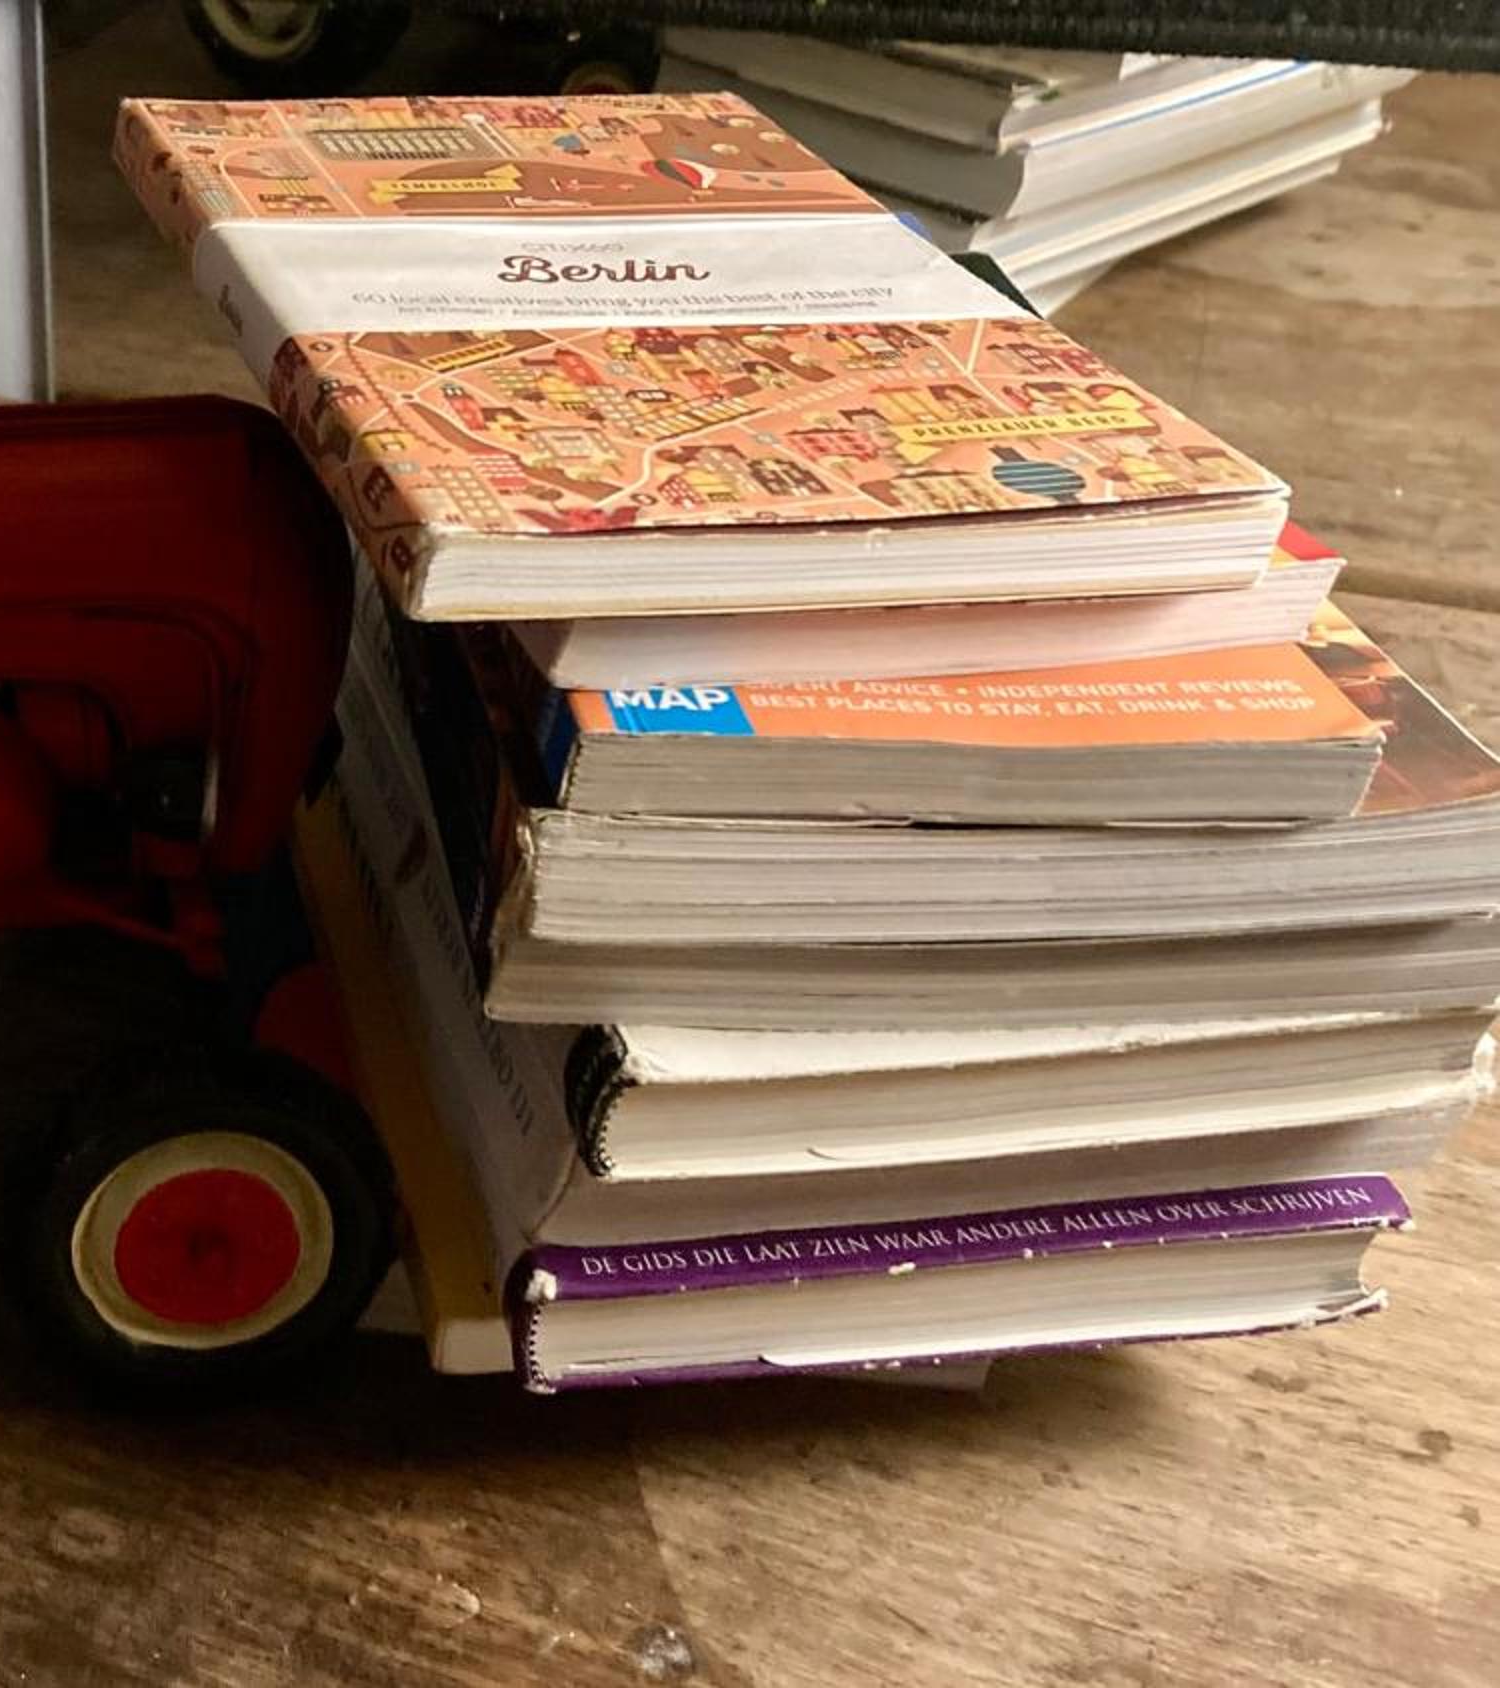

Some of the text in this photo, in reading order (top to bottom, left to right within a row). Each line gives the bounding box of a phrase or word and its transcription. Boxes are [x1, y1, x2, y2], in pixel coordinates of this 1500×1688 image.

[498, 255, 711, 283] Berlin
[390, 289, 450, 304] local
[453, 293, 561, 305] creatives
[563, 297, 631, 308] bring
[633, 298, 679, 308] you
[681, 295, 721, 305] the
[723, 292, 777, 303] best
[780, 290, 803, 300] of
[806, 290, 847, 300] the
[851, 286, 893, 298] city
[912, 415, 1128, 438] PRENZLAUER BERG
[610, 686, 731, 712] MAP
[854, 682, 949, 697] ADVICE
[978, 681, 1170, 699] INDEPENDENT
[1179, 679, 1306, 695] REVIEWS
[749, 694, 821, 710] BEST
[826, 696, 934, 714] PLACES
[938, 700, 974, 716] TO
[978, 702, 1052, 718] STAY,
[1118, 699, 1206, 713] DRINK
[1214, 699, 1236, 712] &
[1239, 696, 1317, 711] SHOP
[581, 1185, 1373, 1275] DE GIDS DIE LAAT ZIEN WAAR ANDERE ALLEEN OVER SCHRIJVEN
